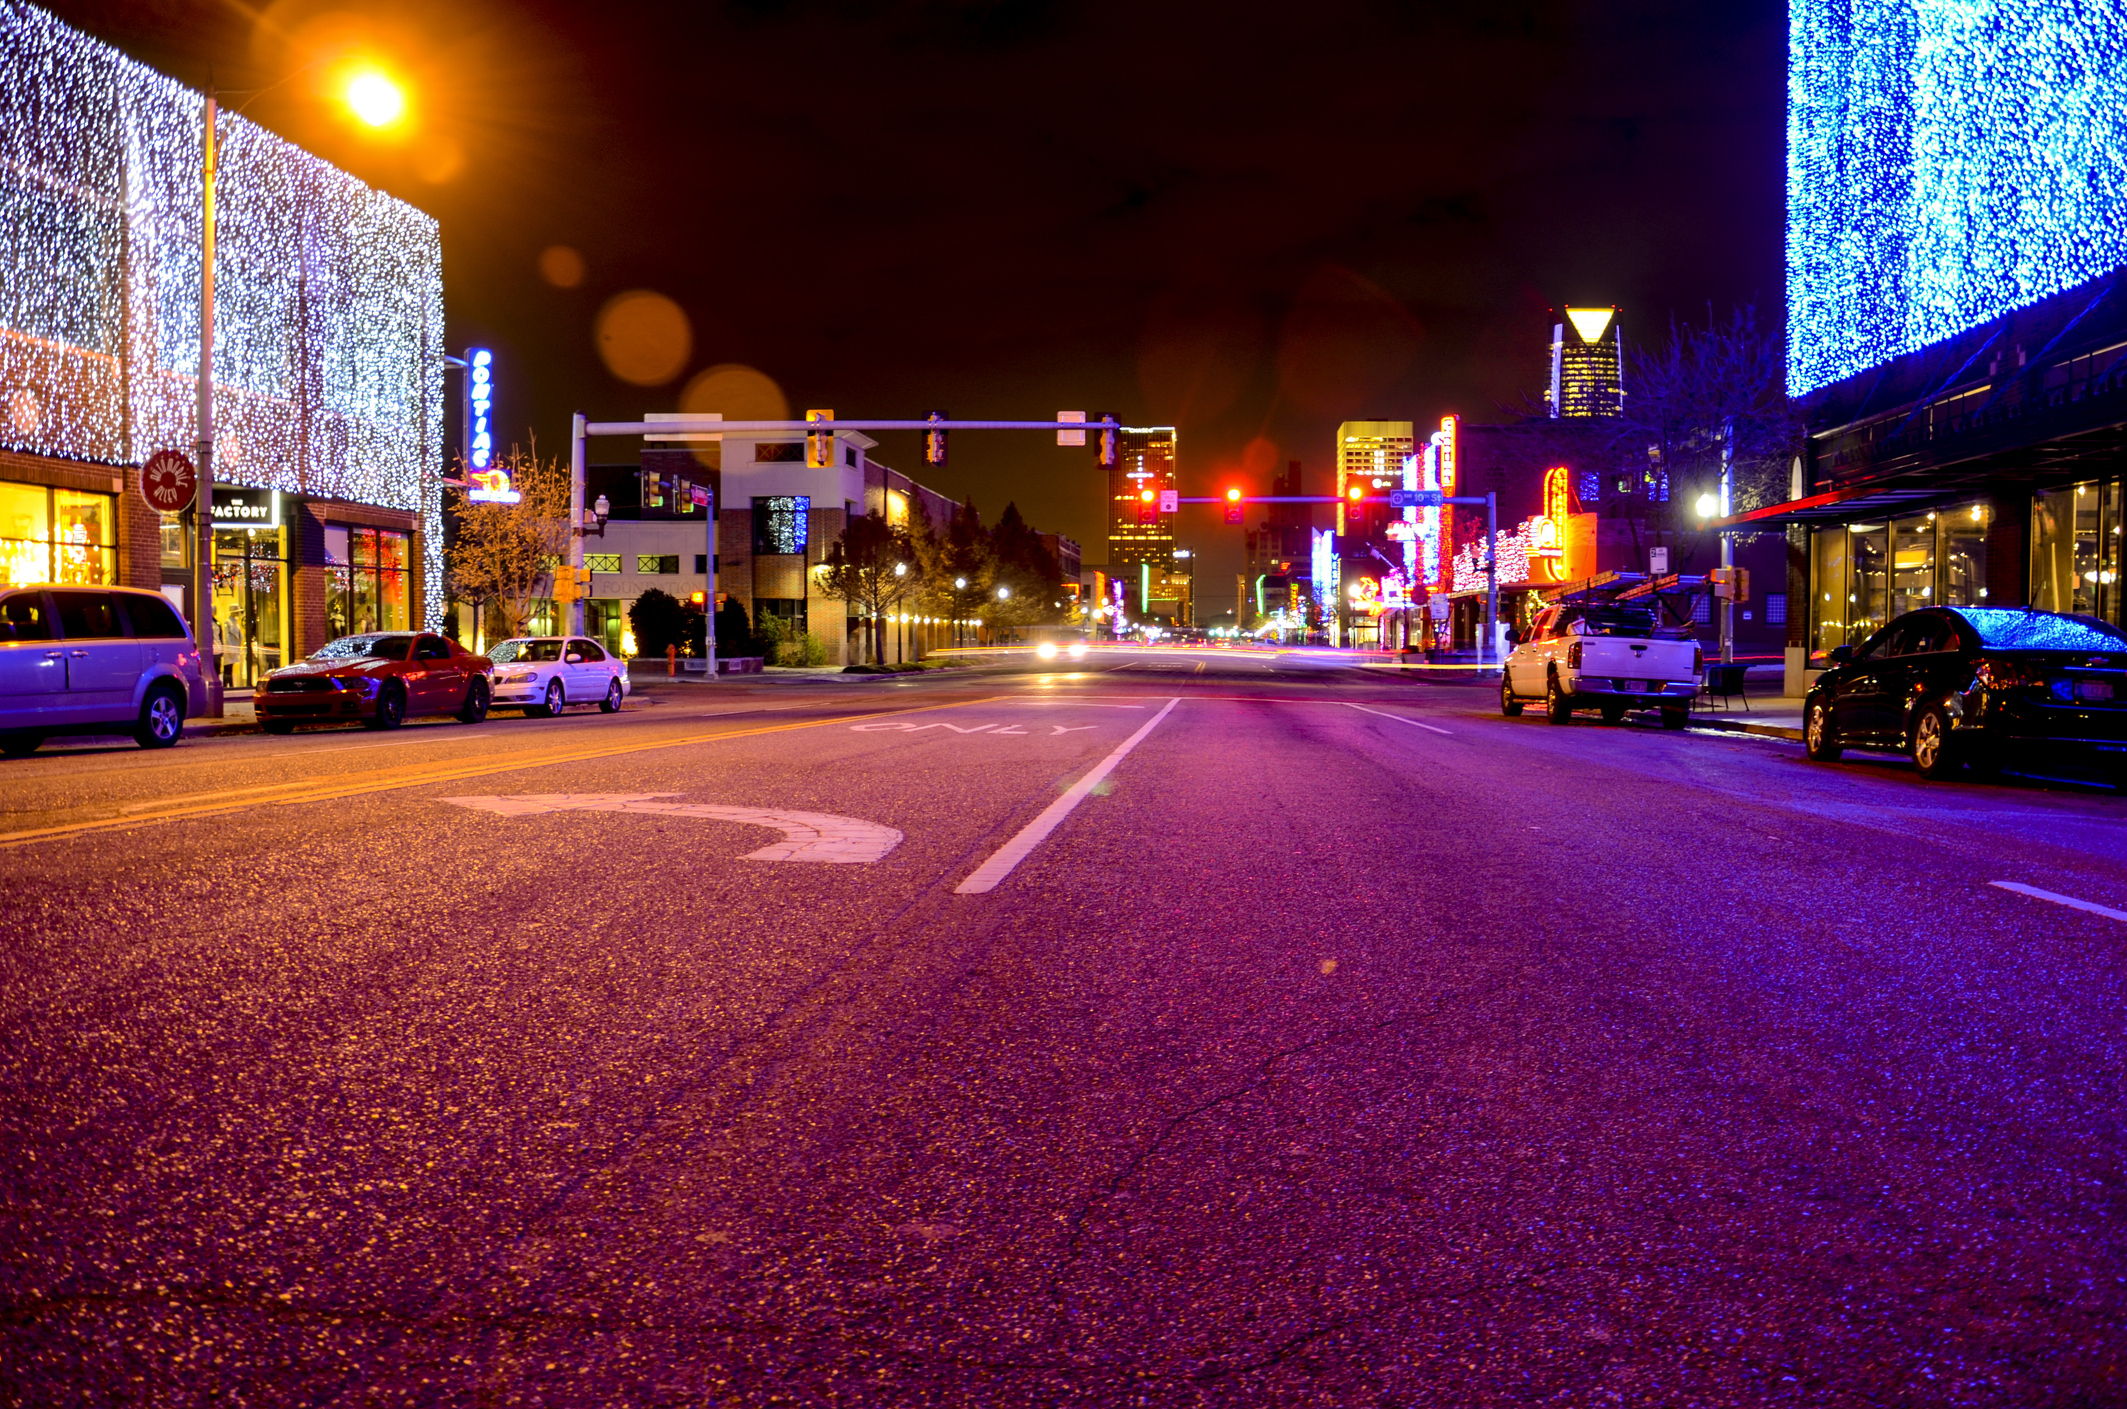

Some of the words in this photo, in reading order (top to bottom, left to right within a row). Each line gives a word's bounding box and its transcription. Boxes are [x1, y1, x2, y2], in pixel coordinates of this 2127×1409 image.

[472, 351, 491, 468] PONTIAC
[150, 458, 188, 488] AUTOMOBILE
[154, 486, 178, 503] ALLEY
[1431, 494, 1442, 502] St
[602, 581, 702, 594] FOUNDATION
[849, 722, 1100, 736] ONLY
